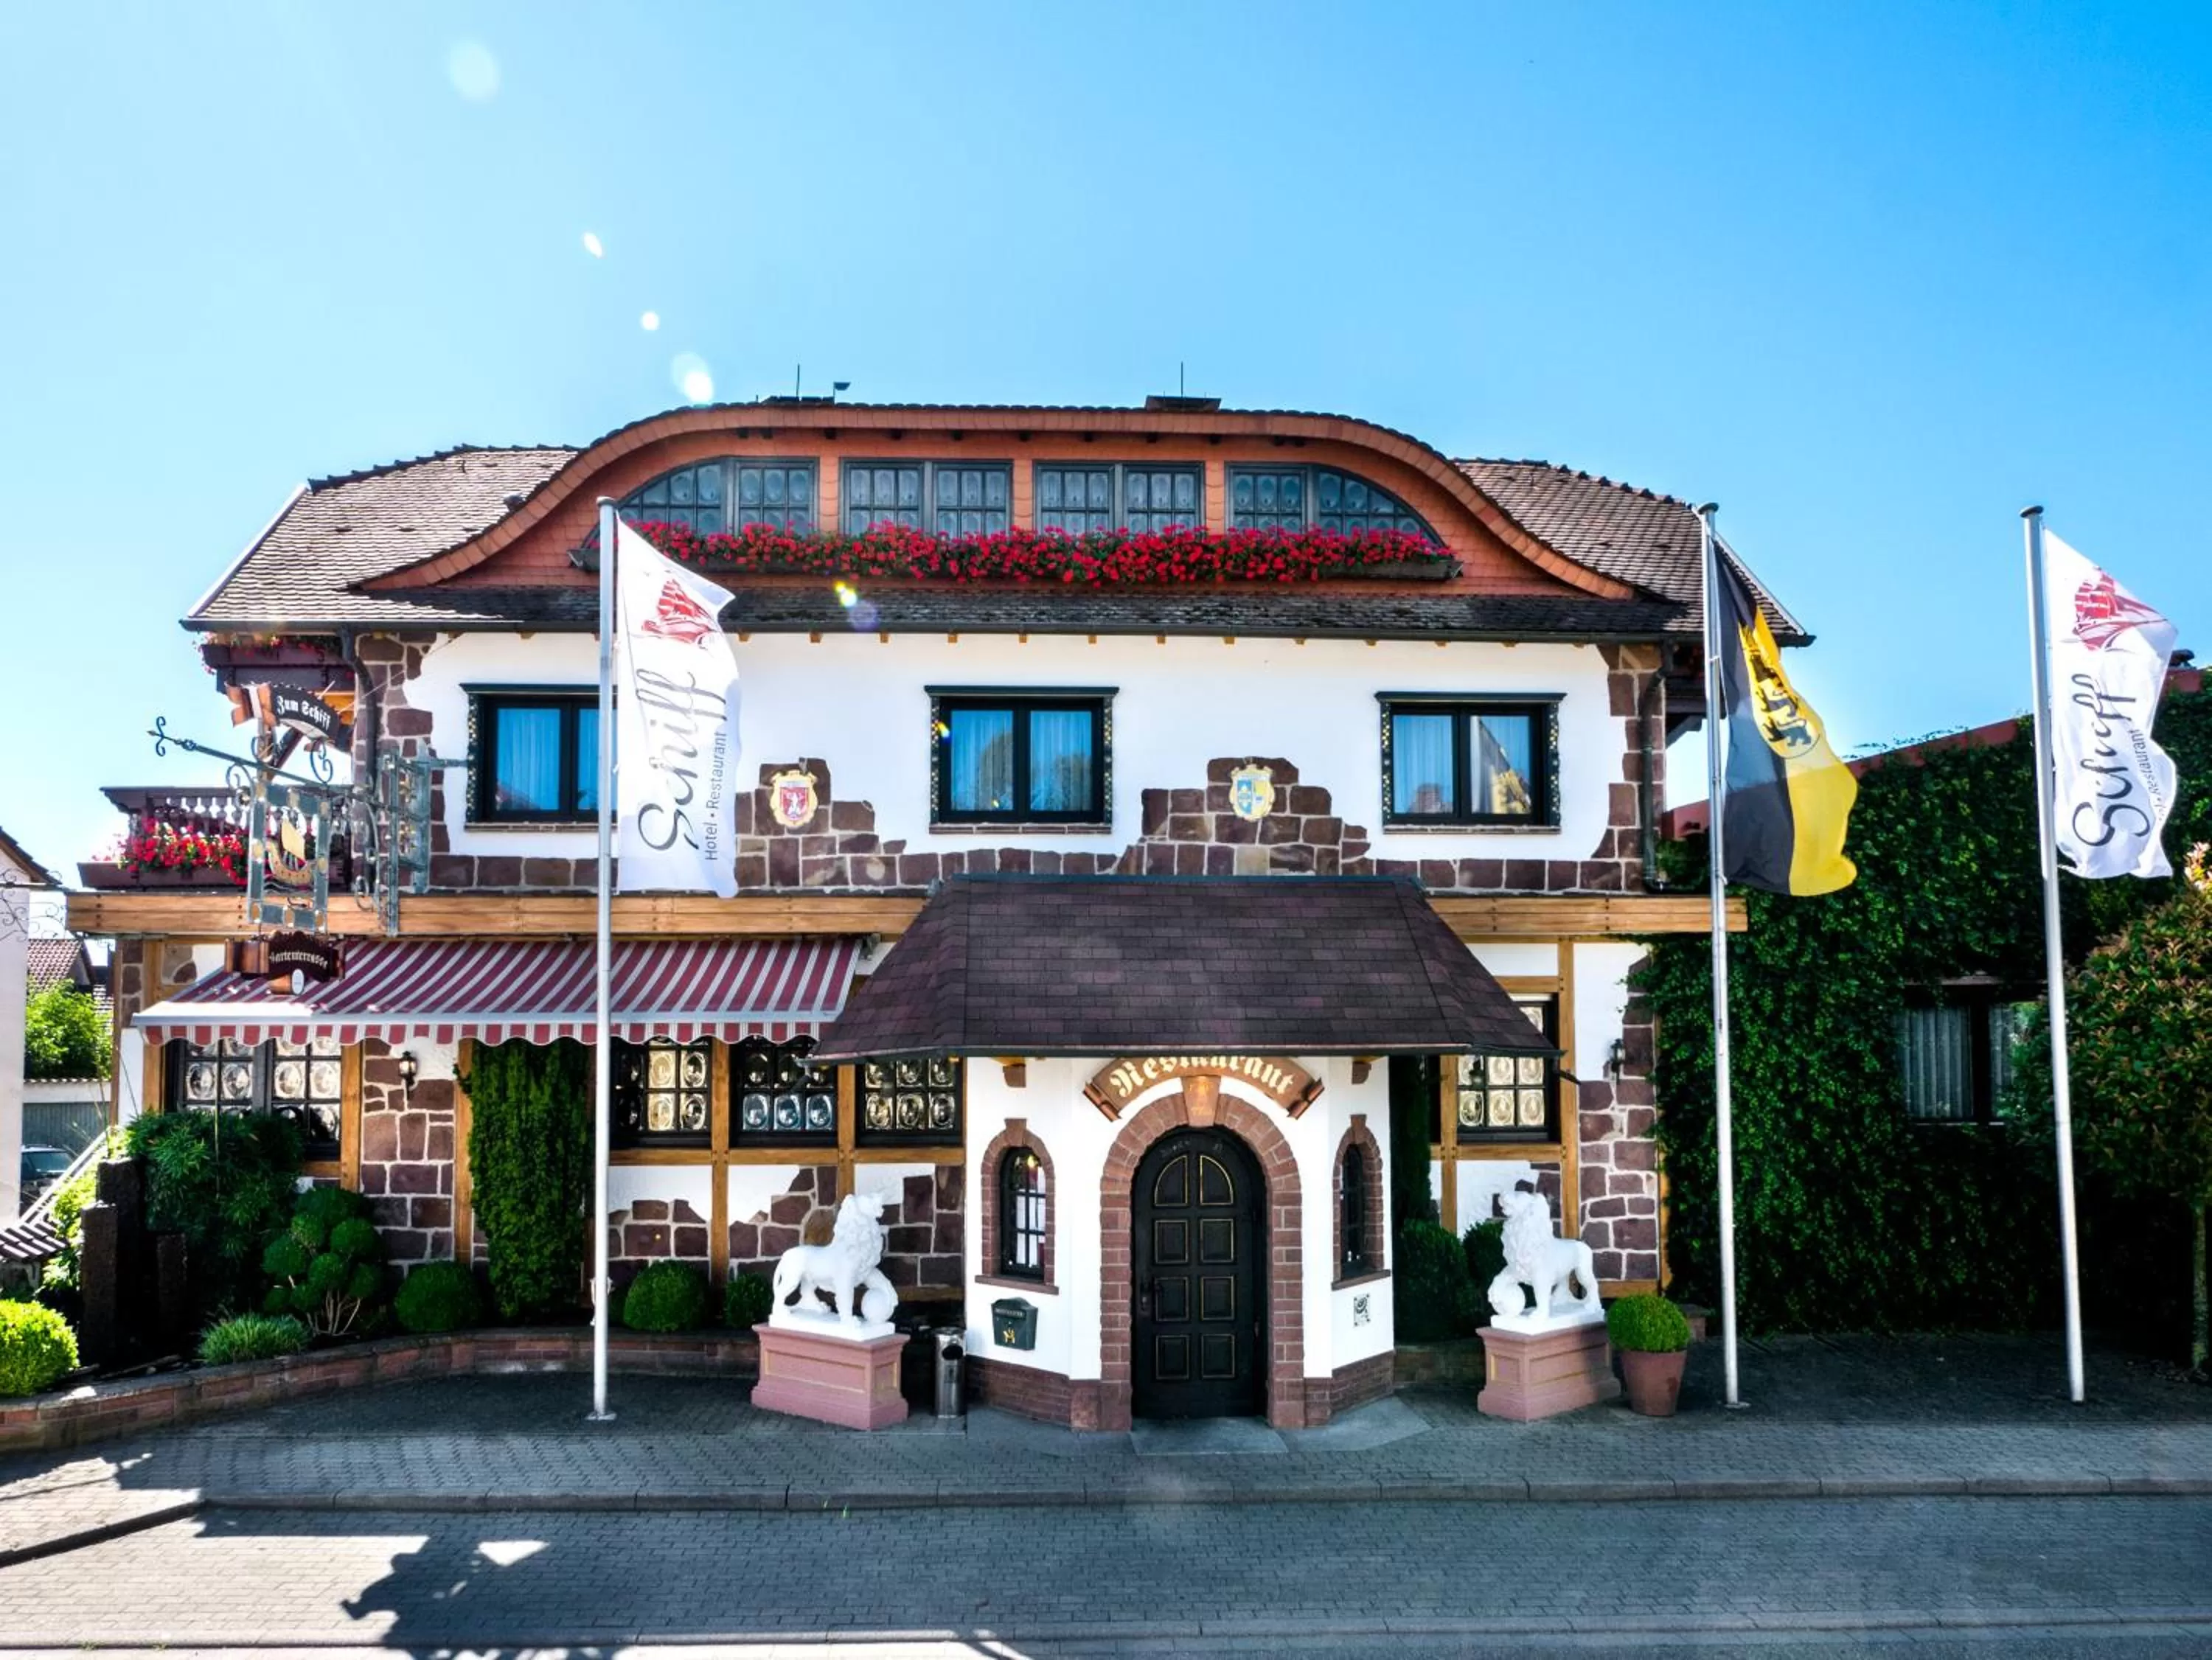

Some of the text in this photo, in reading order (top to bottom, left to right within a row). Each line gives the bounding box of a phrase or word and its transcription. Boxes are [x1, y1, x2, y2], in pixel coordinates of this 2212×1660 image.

[276, 695, 331, 732] Zum Schiff
[703, 730, 728, 861] Hotel Restaurant
